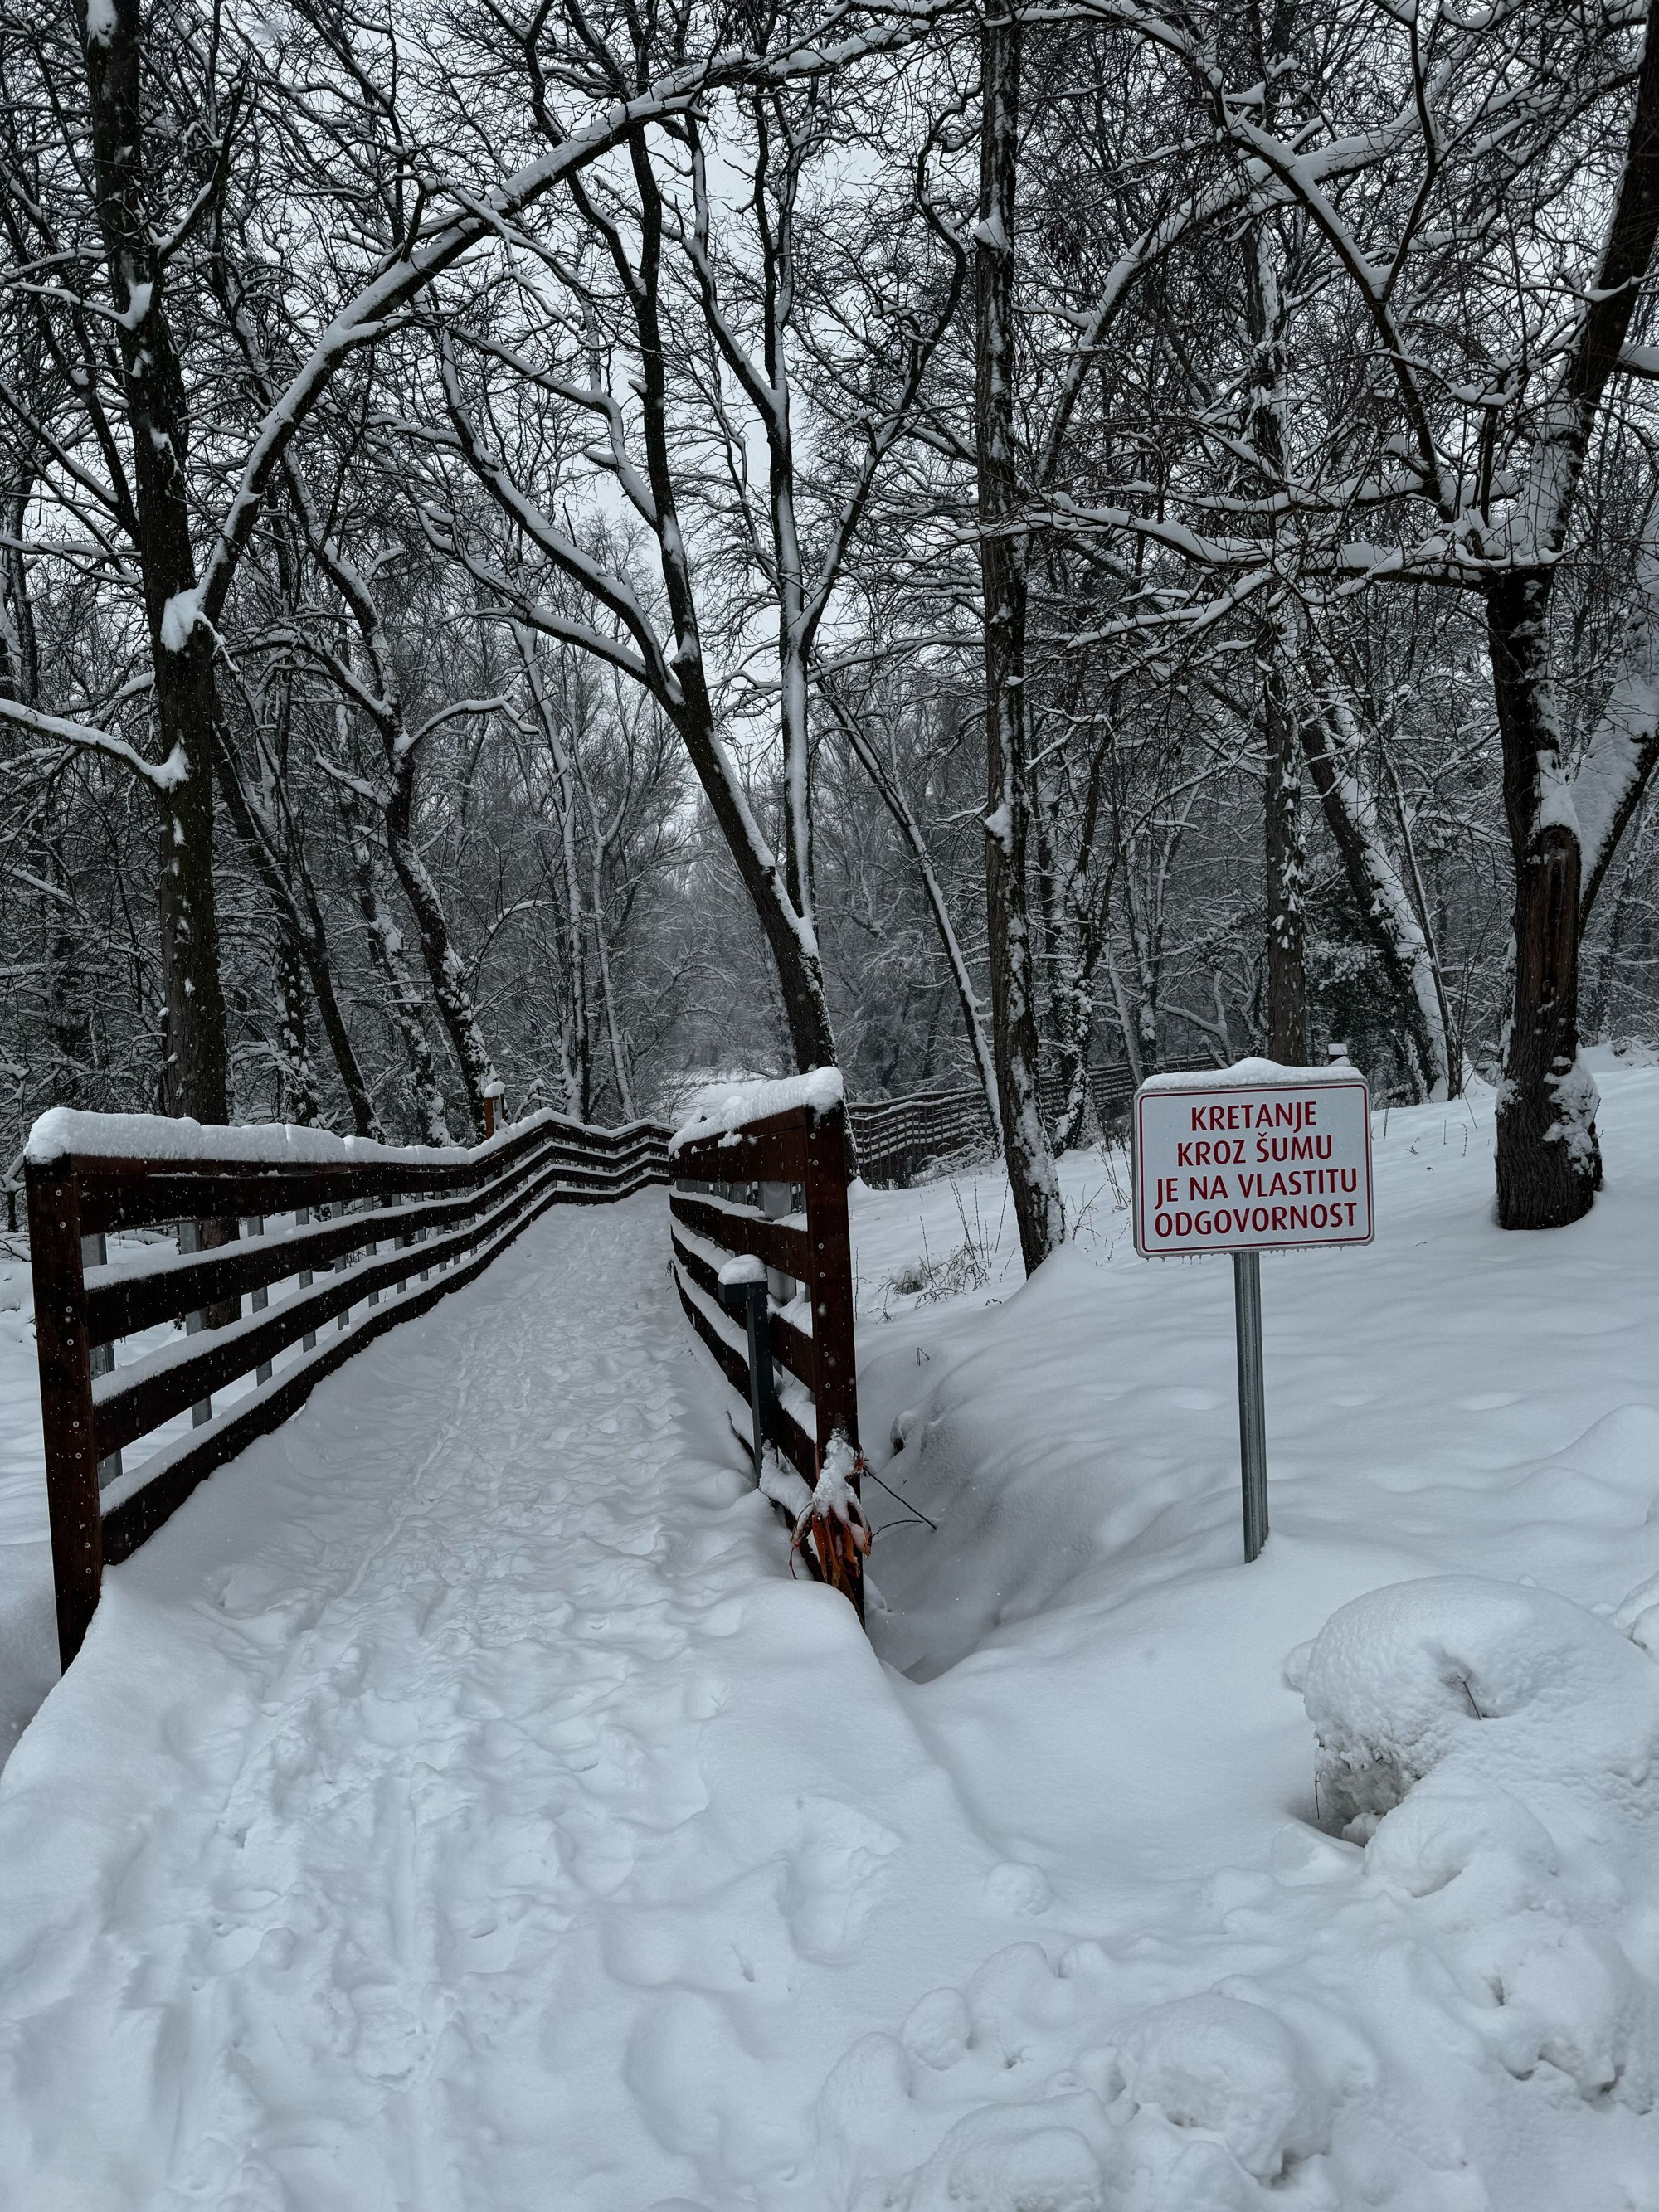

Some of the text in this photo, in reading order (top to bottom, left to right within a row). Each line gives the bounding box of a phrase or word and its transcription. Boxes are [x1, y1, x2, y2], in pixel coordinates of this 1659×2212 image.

[1191, 1101, 1316, 1133] KRETANJE
[1177, 1132, 1332, 1167] KROZ ŠUMU
[1154, 1168, 1357, 1210] JE NA VLASTITU
[1155, 1203, 1357, 1237] ODGOVORNOST
